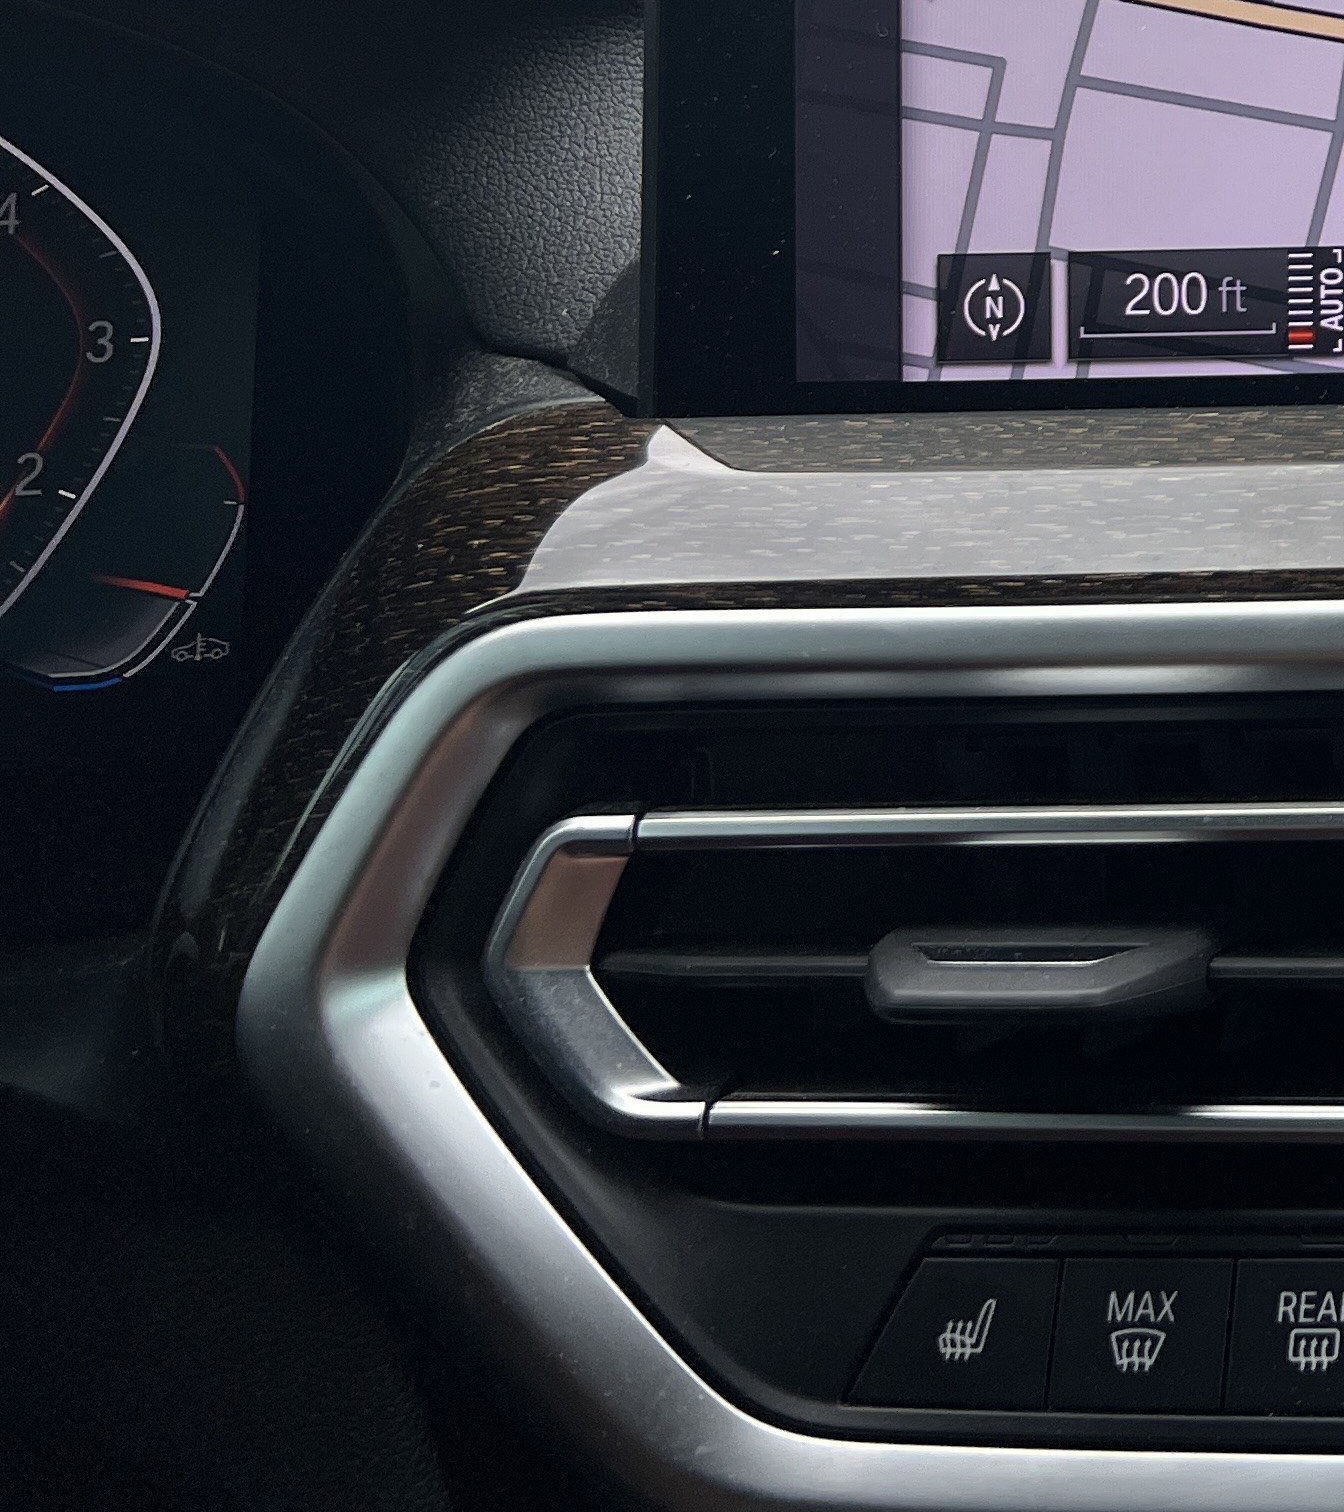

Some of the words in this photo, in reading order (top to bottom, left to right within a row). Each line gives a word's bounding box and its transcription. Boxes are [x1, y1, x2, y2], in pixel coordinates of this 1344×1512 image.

[985, 295, 1004, 319] N
[1125, 271, 1208, 316] 200
[1218, 276, 1248, 313] ft
[1319, 267, 1344, 332] AUTO
[86, 320, 114, 364] 3
[15, 452, 43, 496] 2
[1107, 1290, 1178, 1323] MAX
